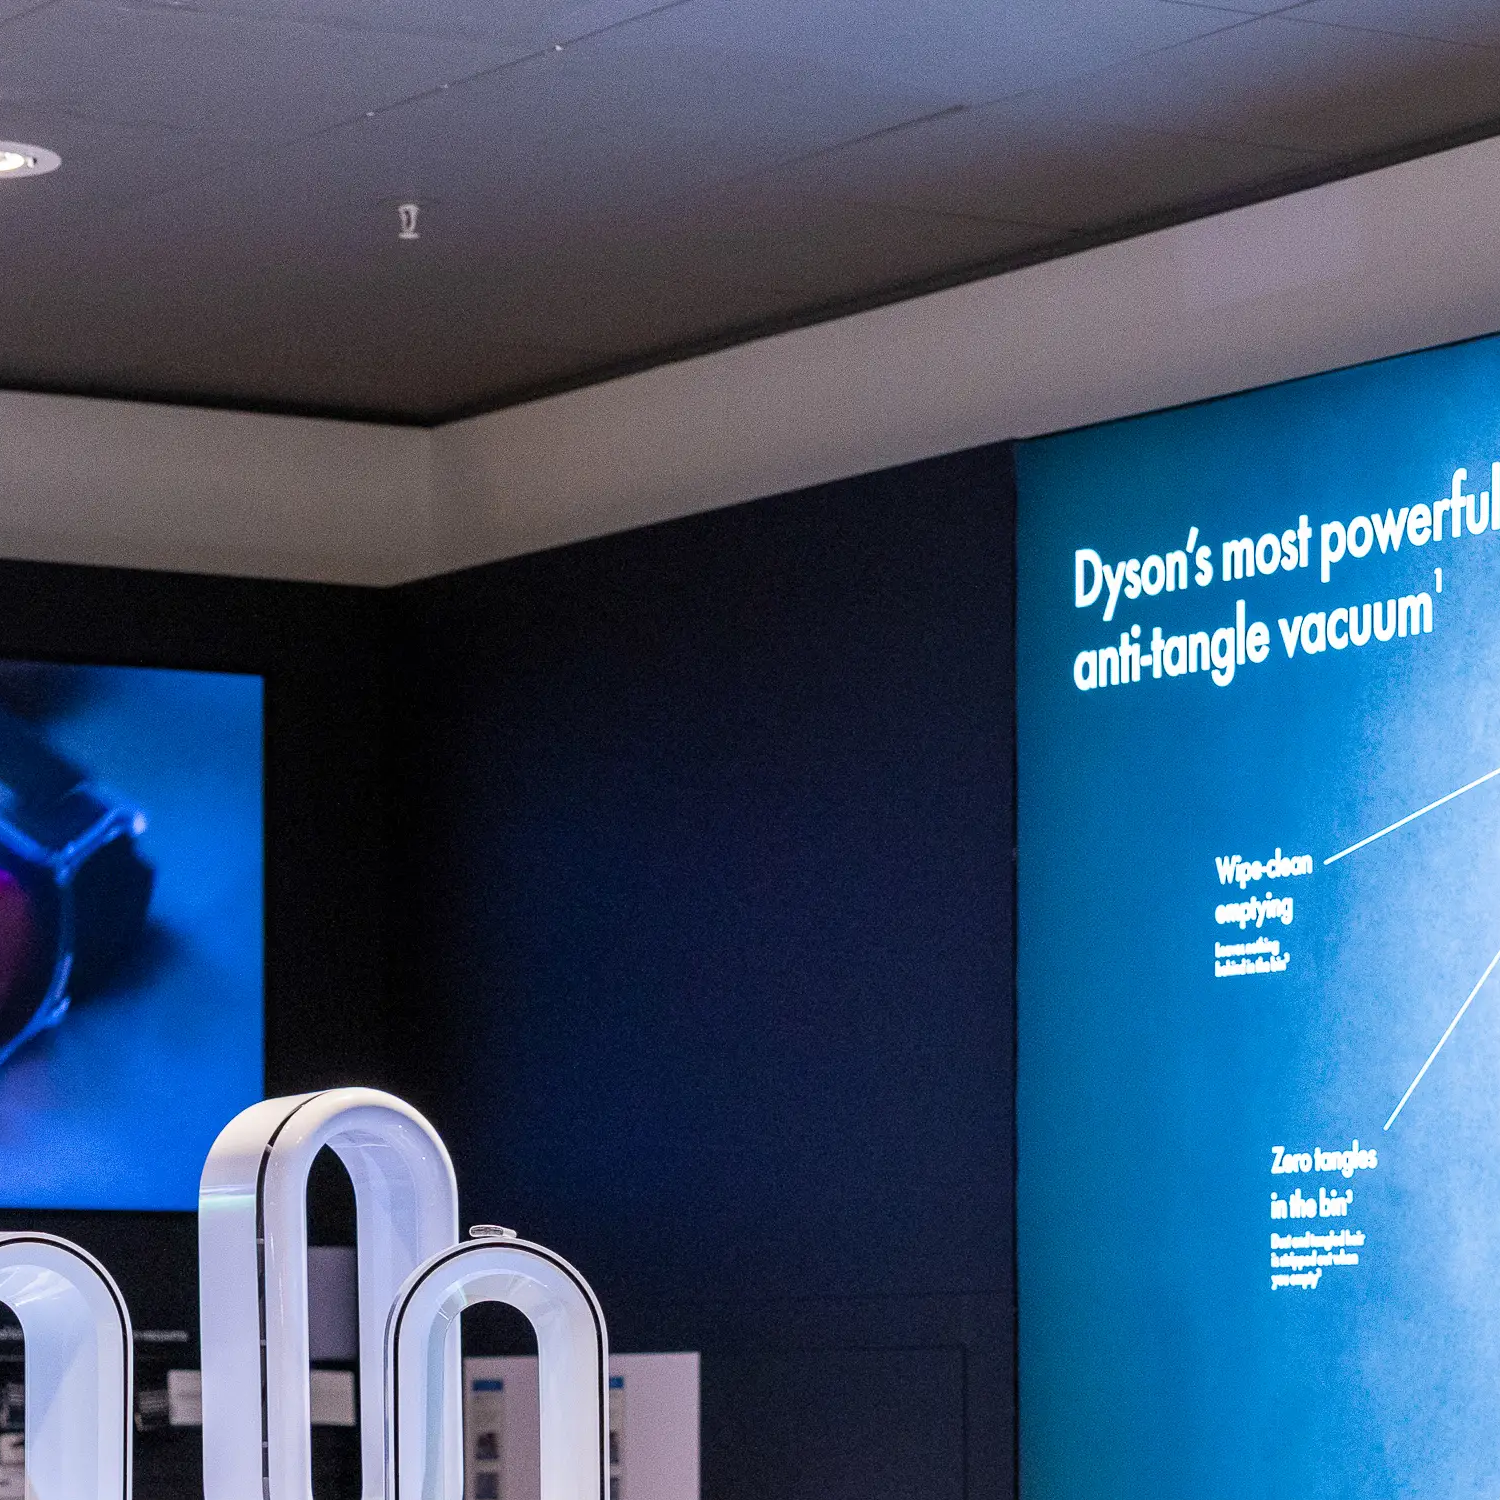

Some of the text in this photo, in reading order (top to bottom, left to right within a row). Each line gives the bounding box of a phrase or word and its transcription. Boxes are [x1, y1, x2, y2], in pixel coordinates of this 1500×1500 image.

[1074, 526, 1214, 622] Dyson's
[1222, 514, 1312, 582] most
[1073, 599, 1270, 691] anti-tangle
[1215, 847, 1313, 890] Wipe-clean
[1215, 891, 1294, 930] emptying
[1271, 1139, 1378, 1179] Zero tangles
[1271, 1192, 1288, 1219] in
[1288, 1188, 1317, 1219] the
